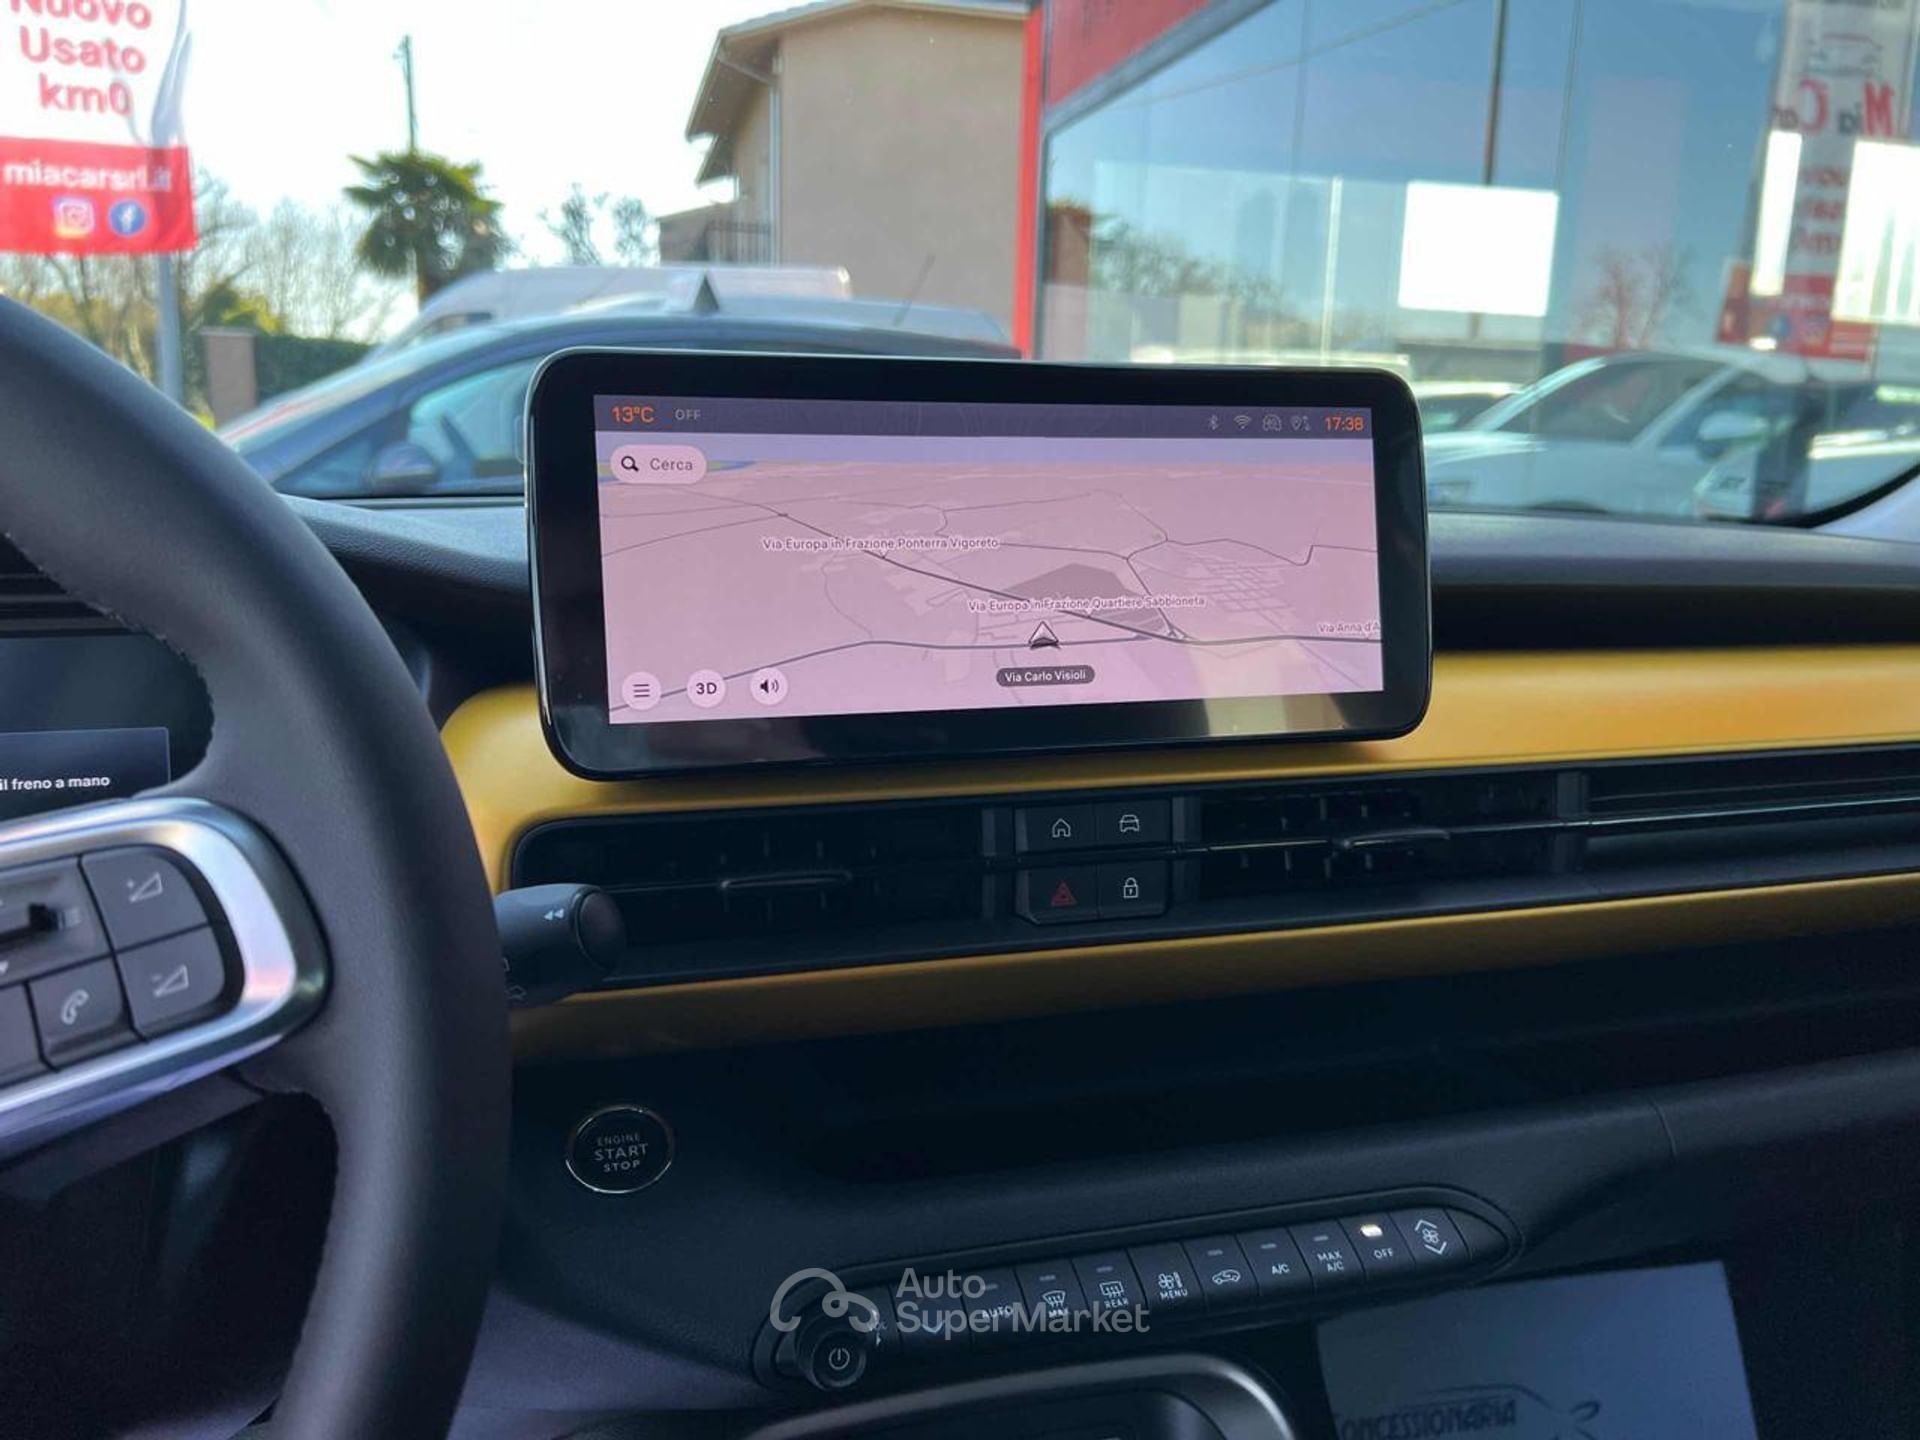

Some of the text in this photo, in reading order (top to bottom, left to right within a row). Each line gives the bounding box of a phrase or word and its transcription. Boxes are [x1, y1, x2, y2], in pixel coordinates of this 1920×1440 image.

[19, 25, 146, 74] Usato
[39, 73, 133, 116] km0
[674, 409, 702, 422] OFF
[1324, 417, 1364, 432] 17:38
[649, 457, 693, 472] Cerca
[762, 537, 784, 550] Via
[785, 537, 829, 552] Europa
[845, 537, 897, 550] Frazione
[898, 537, 947, 549] Ponterra
[949, 537, 998, 552] Vigoreto
[968, 600, 986, 611] Via
[989, 599, 1029, 612] Europa
[1092, 597, 1142, 609] Quartiere
[1144, 596, 1205, 608] Sabbioneta
[1318, 623, 1335, 633] Via
[1336, 622, 1362, 633] Anna
[1004, 669, 1086, 682] Via Carlo Visioli
[695, 682, 717, 695] 3D
[11, 777, 52, 791] freno
[55, 778, 65, 789] a
[67, 776, 111, 787] mano
[597, 1133, 640, 1147] ENGINE
[593, 1143, 649, 1162] START
[603, 1159, 641, 1173] STOP
[1317, 1250, 1342, 1263] MAX
[1373, 1247, 1395, 1260] OFF
[1271, 1262, 1291, 1275] A/C
[1325, 1260, 1345, 1273] A/C
[1159, 1287, 1188, 1301] MENU
[981, 1304, 1014, 1320] AUTO
